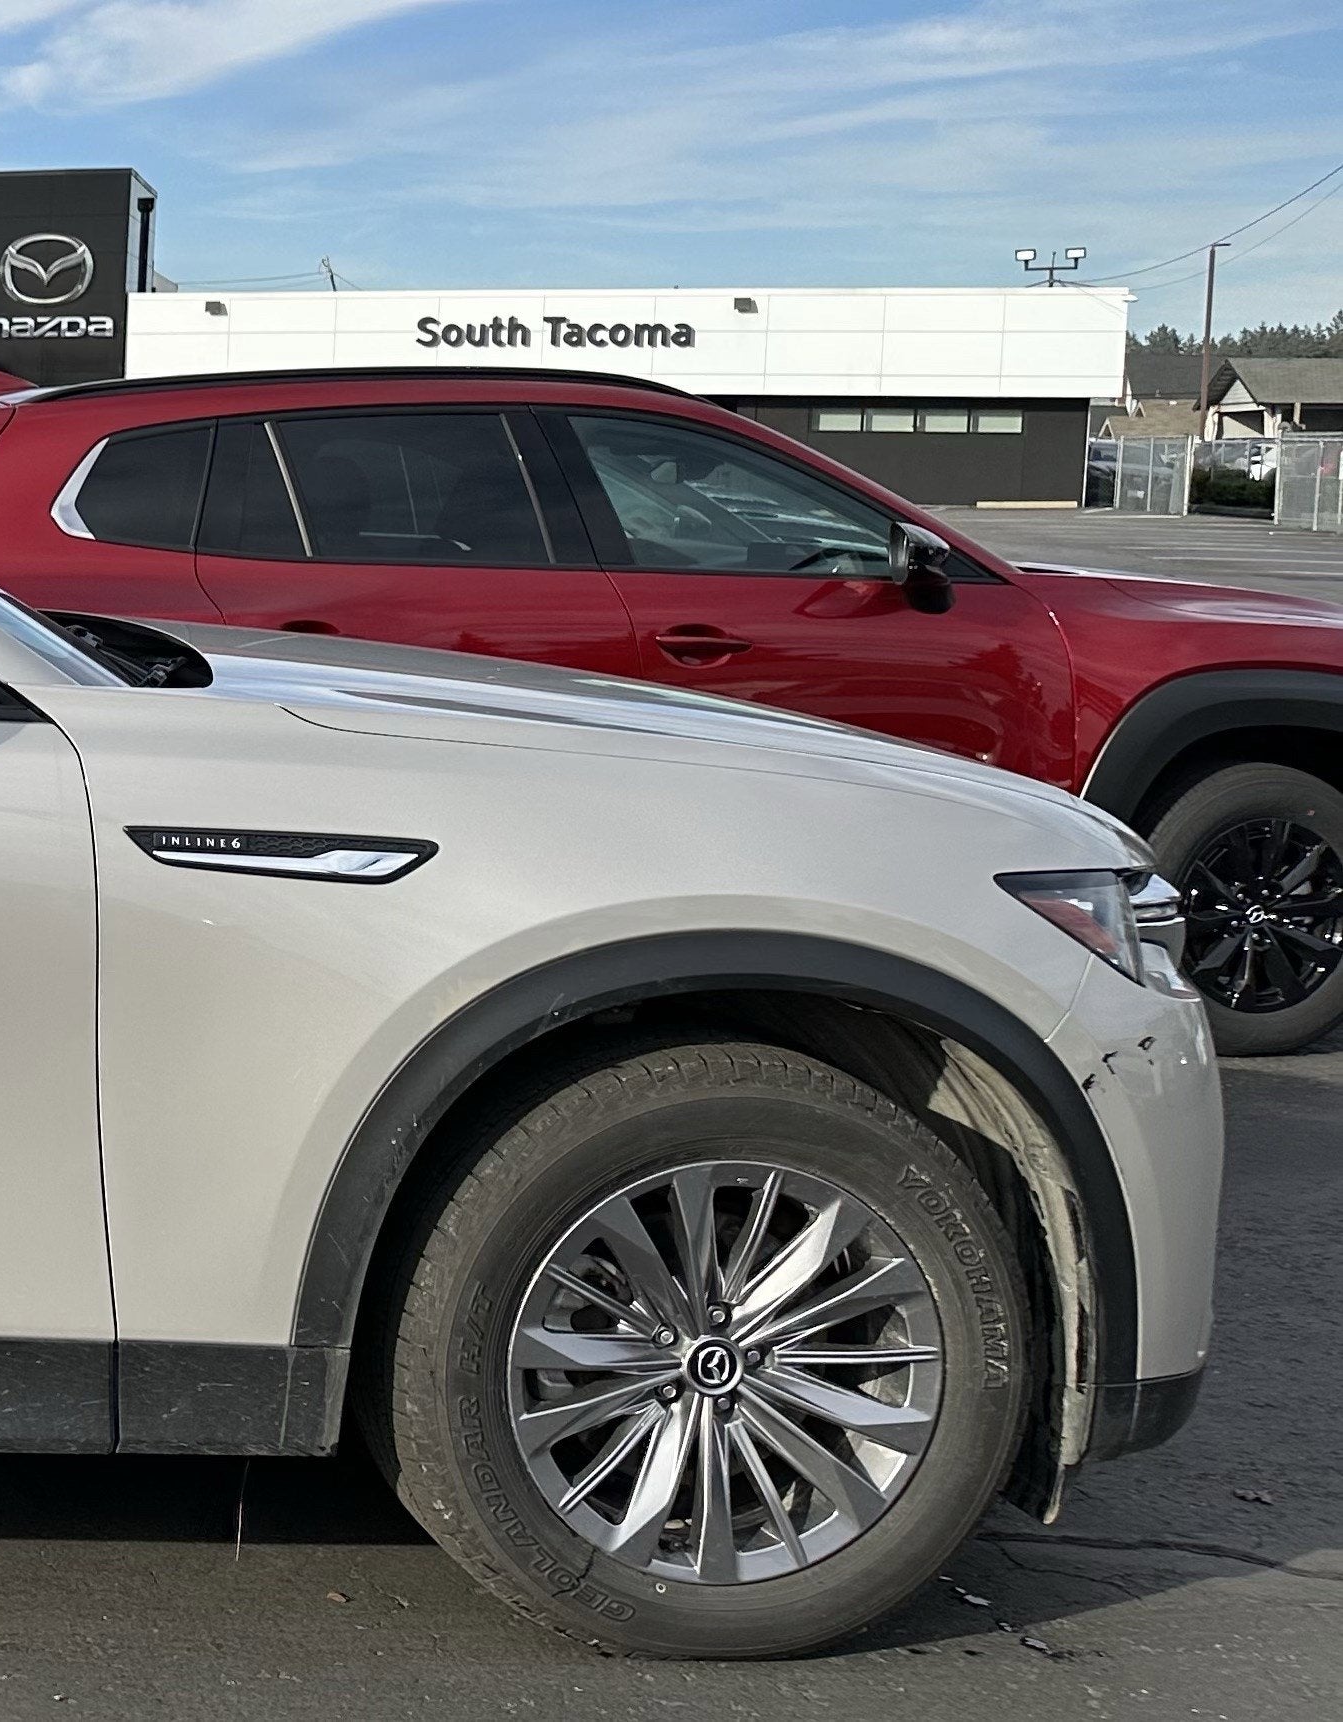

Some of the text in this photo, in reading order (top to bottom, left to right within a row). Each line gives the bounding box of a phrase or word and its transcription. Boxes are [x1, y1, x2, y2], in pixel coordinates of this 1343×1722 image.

[415, 315, 695, 348] South Tacoma
[897, 1164, 1010, 1390] YOKOHAMA
[458, 1394, 636, 1623] GEOLANDAR
